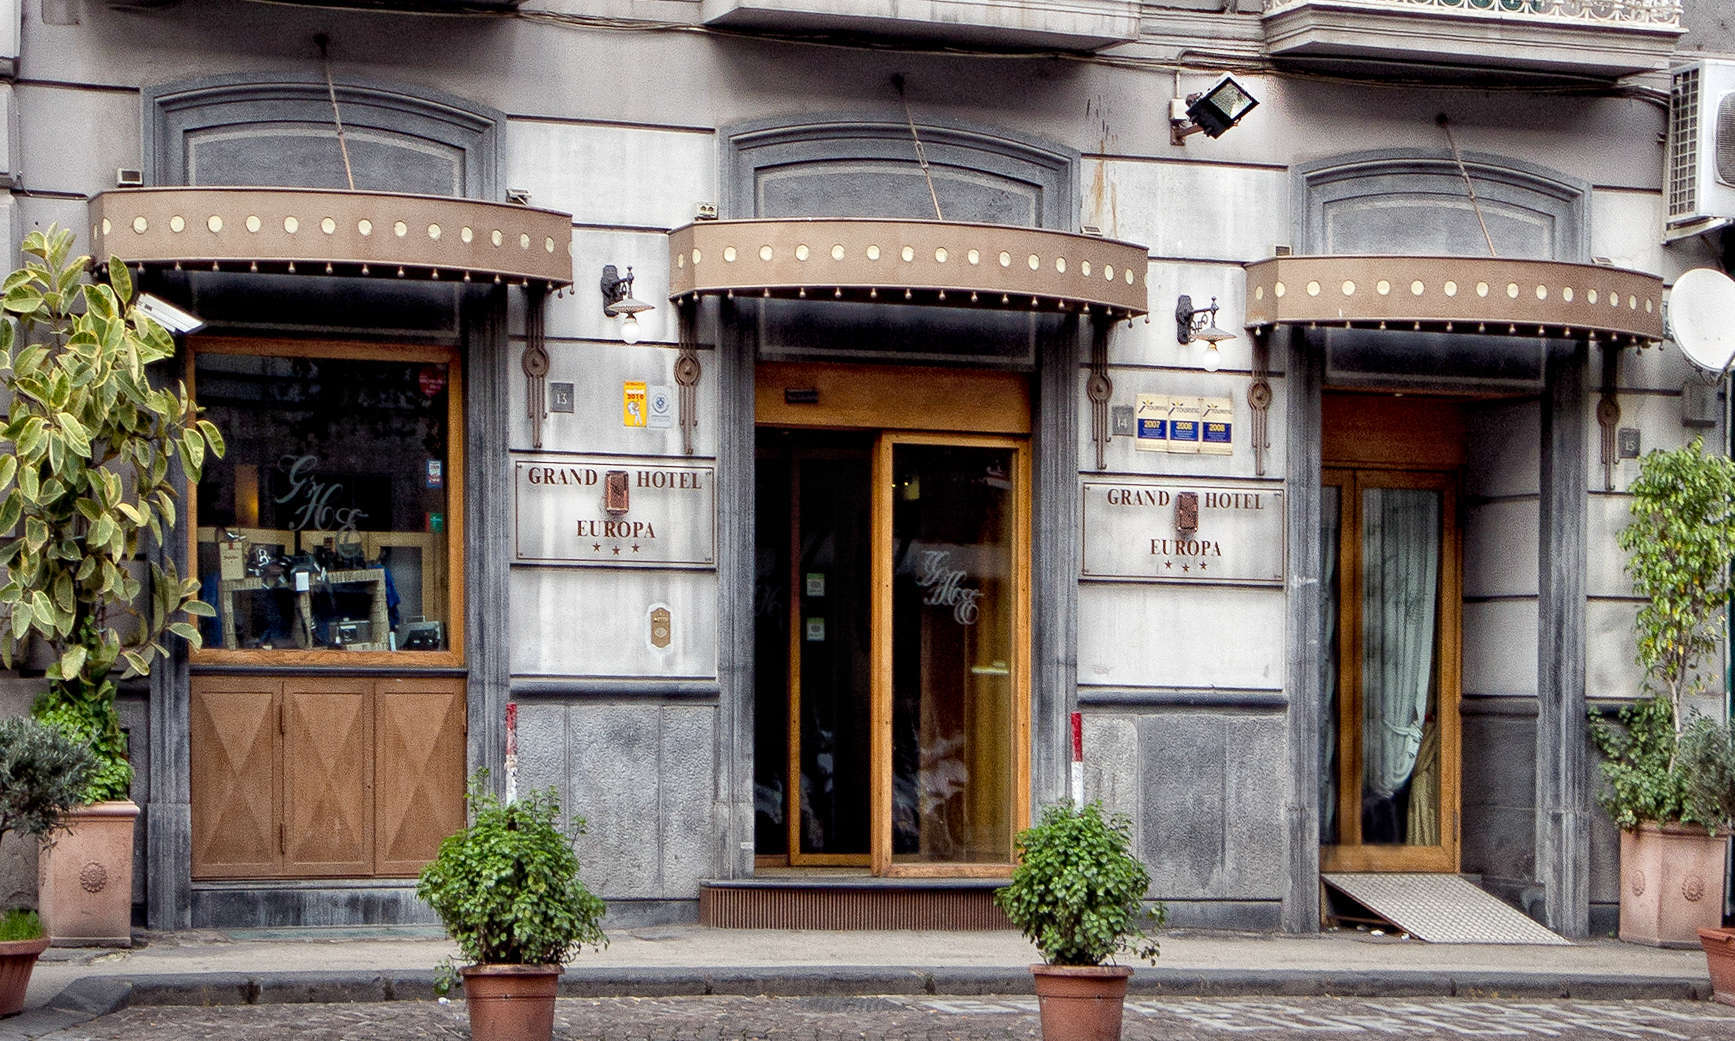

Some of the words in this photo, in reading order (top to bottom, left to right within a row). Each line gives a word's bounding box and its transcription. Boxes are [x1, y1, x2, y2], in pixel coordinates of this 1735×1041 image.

[528, 468, 598, 486] GRAND
[636, 471, 702, 489] HOTEL
[1107, 488, 1170, 507] GRAND
[1205, 492, 1264, 510] HOTEL
[576, 519, 656, 539] EUROPA
[1150, 538, 1221, 557] EUROPA
